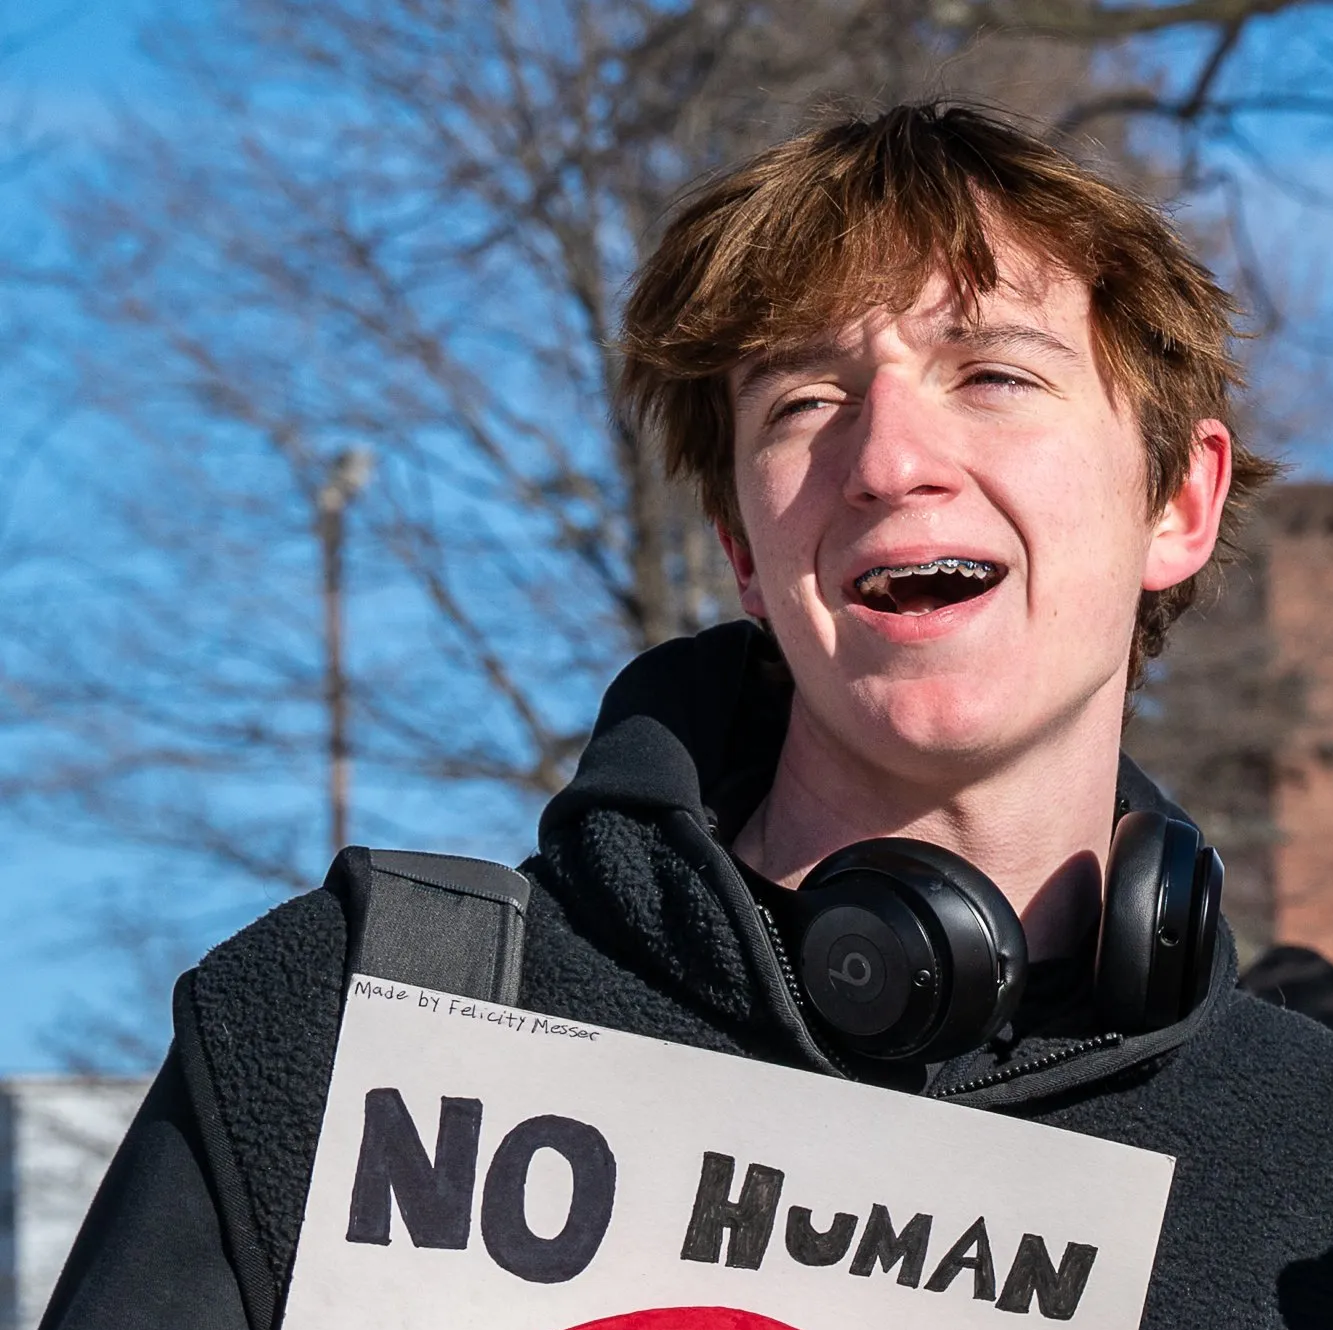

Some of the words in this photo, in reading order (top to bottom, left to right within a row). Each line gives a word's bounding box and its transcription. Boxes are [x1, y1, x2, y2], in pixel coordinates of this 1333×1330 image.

[354, 980, 409, 1001] Made
[418, 990, 440, 1012] by
[449, 998, 526, 1032] Felicity
[531, 1017, 601, 1042] Messer
[346, 1087, 616, 1284] NO
